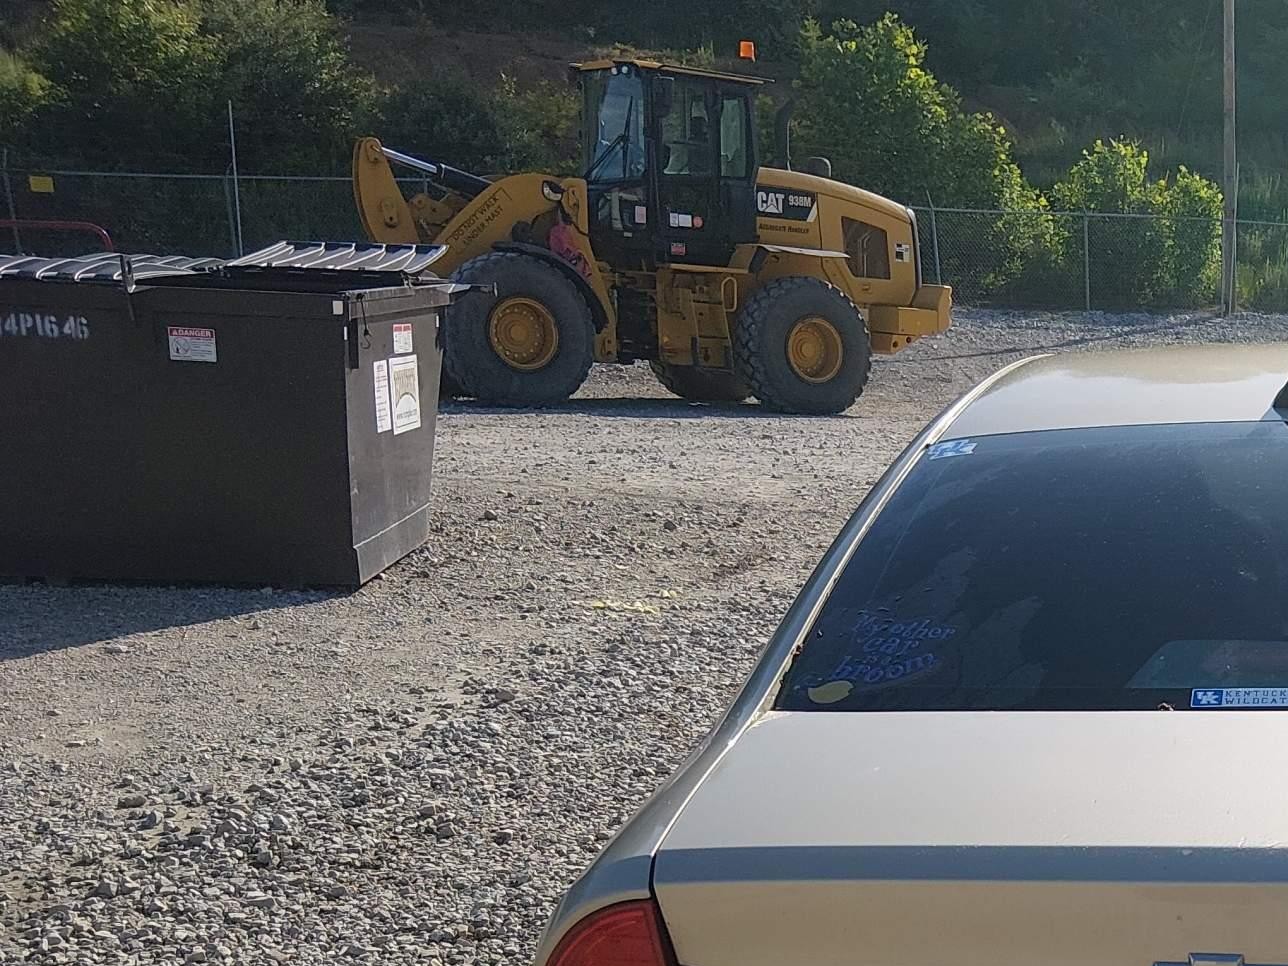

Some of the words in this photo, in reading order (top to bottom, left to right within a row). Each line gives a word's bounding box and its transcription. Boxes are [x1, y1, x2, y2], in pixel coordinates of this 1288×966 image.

[757, 191, 785, 214] CAT
[788, 195, 812, 208] 938M
[890, 619, 956, 640] other
[863, 637, 920, 655] car
